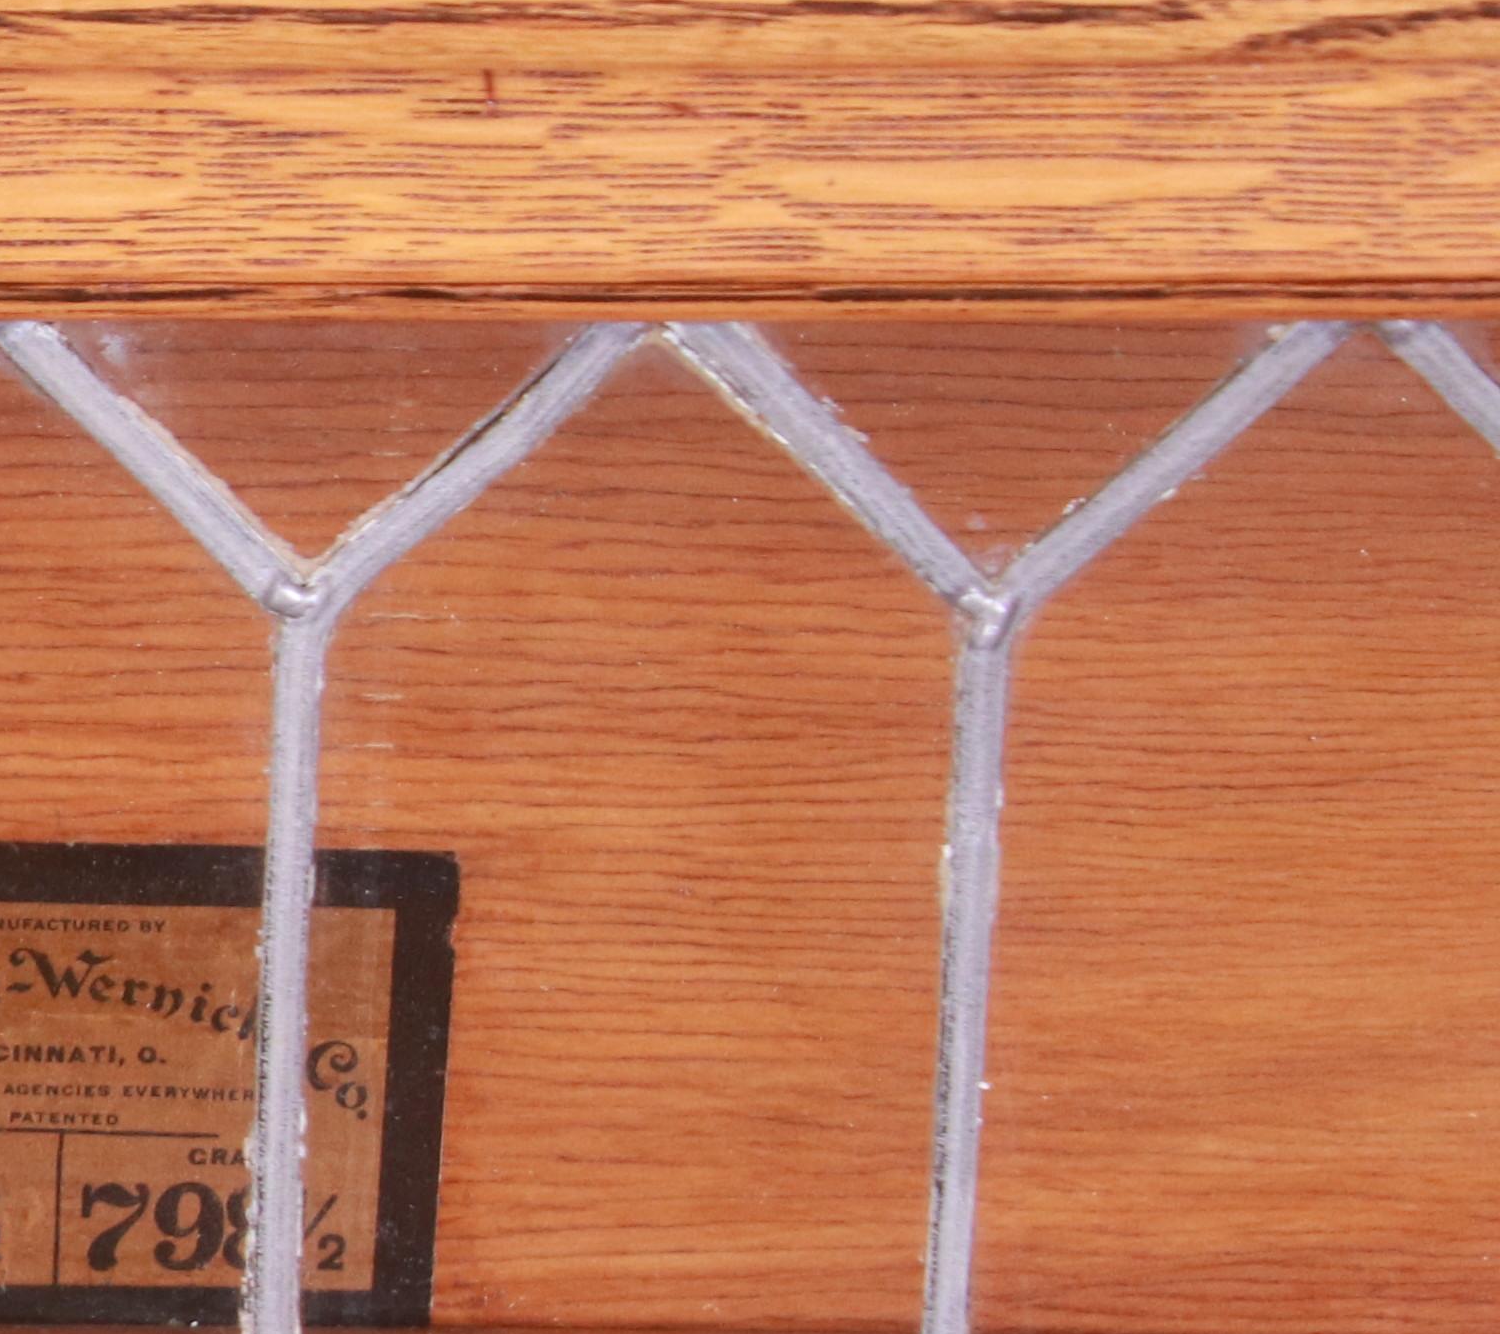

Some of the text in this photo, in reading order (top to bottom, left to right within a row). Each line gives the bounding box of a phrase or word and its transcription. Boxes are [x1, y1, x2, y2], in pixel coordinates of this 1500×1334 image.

[140, 920, 166, 934] BY
[137, 1045, 168, 1065] O.
[305, 1039, 368, 1120] Co.
[3, 1082, 112, 1098] AGENCIES
[122, 1084, 255, 1102] EVERYWHER
[9, 1111, 120, 1126] PATENTED
[188, 1147, 246, 1165] GRA
